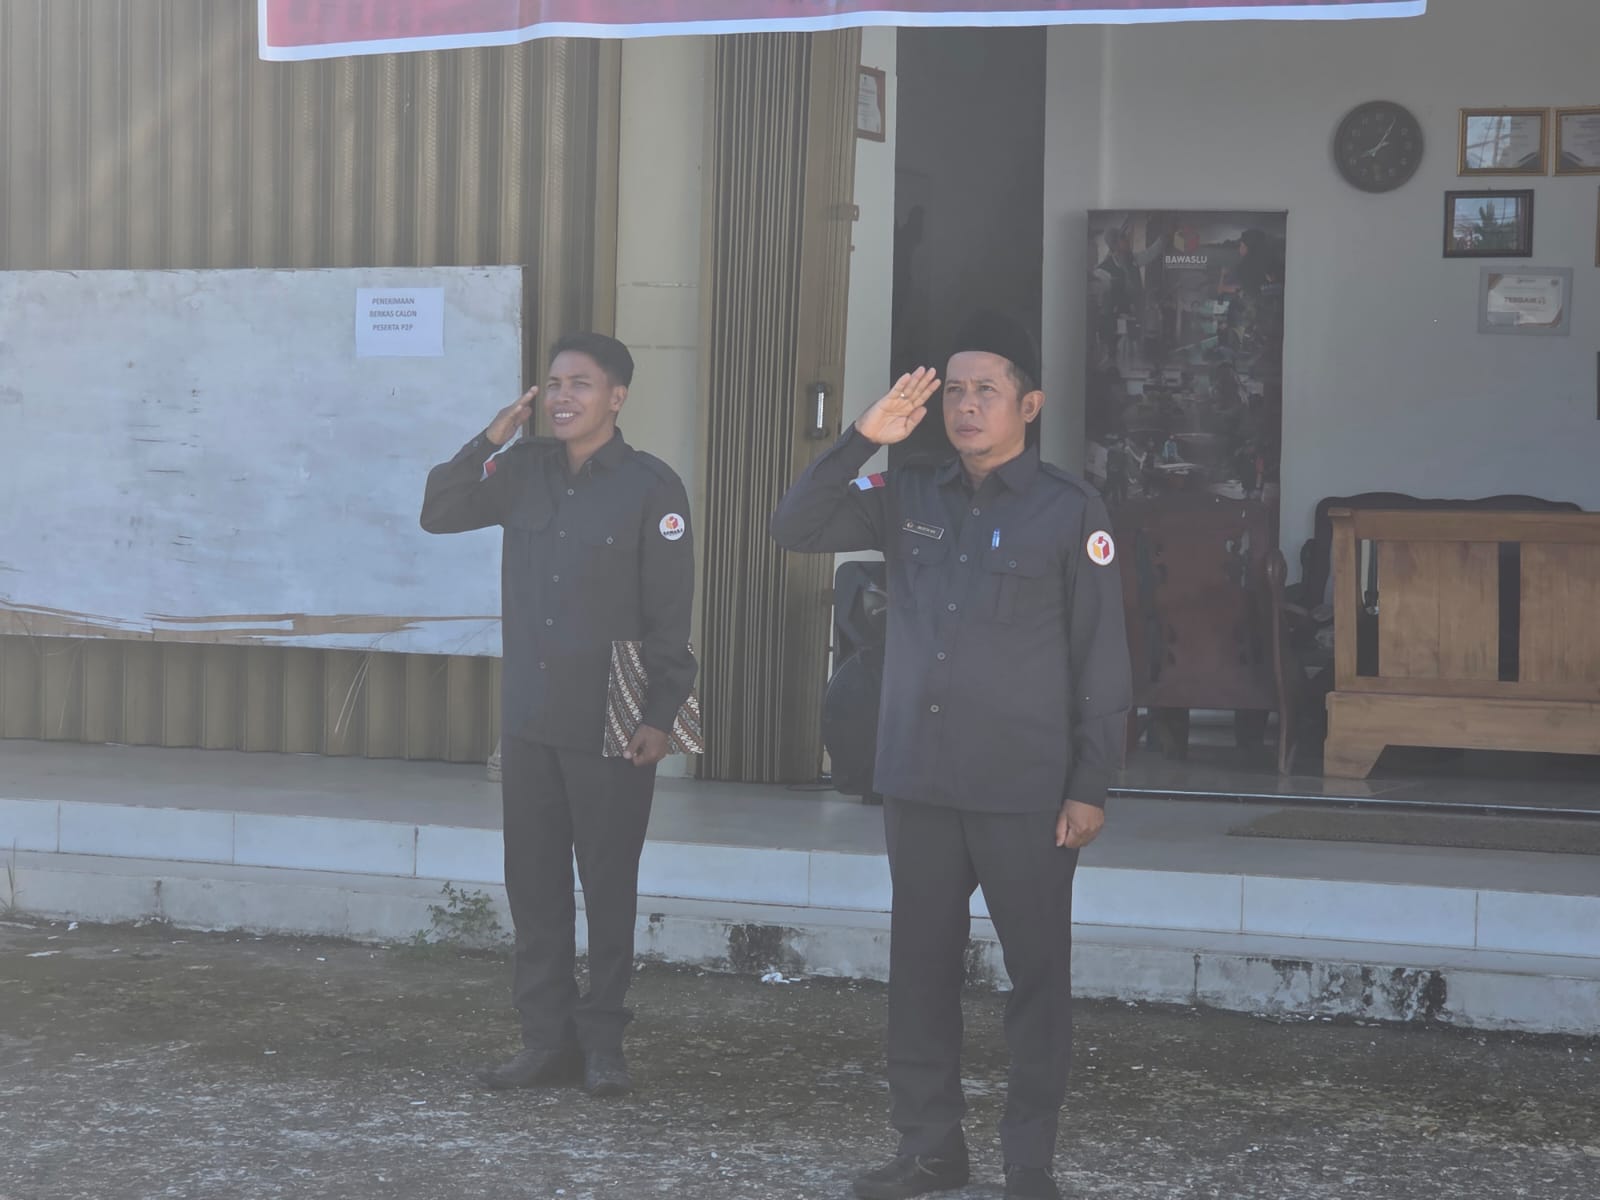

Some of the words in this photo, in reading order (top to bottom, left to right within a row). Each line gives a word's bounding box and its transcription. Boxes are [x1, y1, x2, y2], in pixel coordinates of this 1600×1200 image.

[1165, 255, 1208, 264] BAWASLU
[371, 297, 416, 305] PENERIMAAN
[369, 310, 394, 318] BERKAS
[395, 310, 417, 318] CALON
[372, 323, 399, 331] PESERTA
